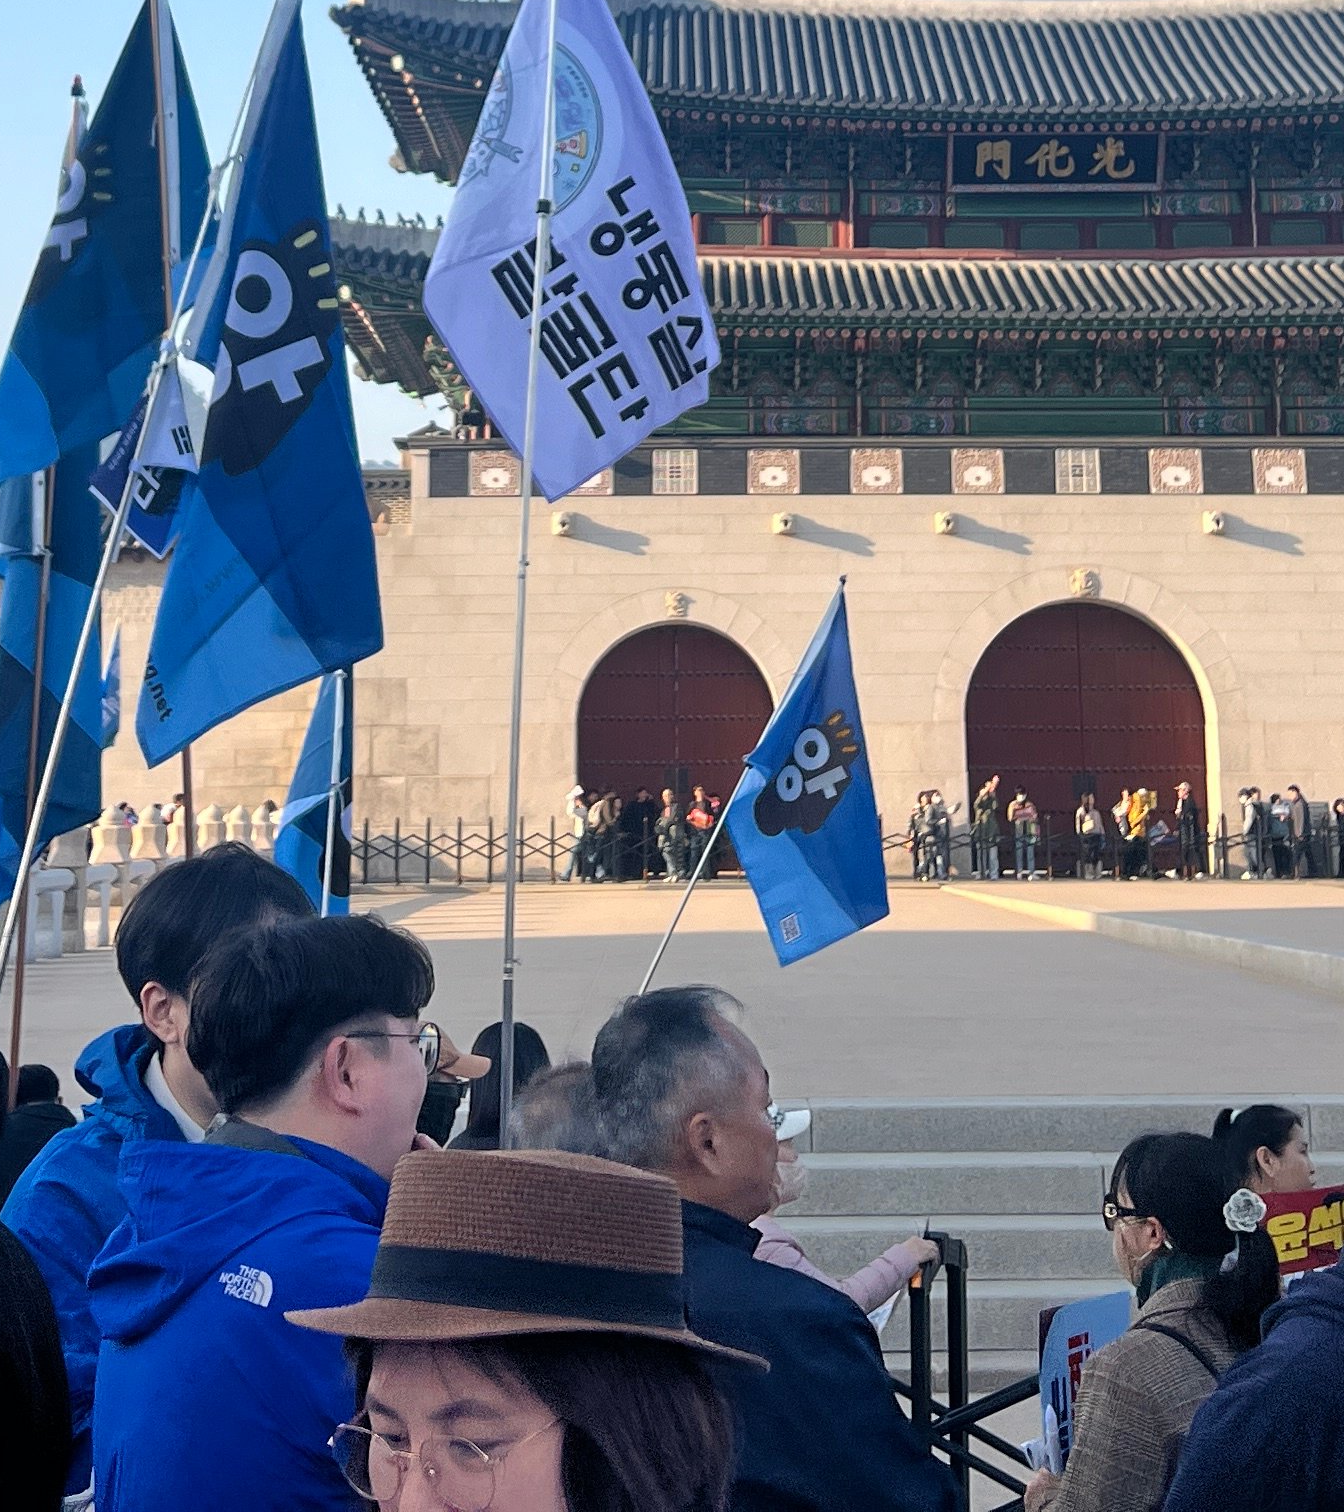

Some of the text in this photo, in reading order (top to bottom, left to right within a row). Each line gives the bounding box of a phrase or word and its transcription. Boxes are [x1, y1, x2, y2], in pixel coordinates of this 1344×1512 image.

[590, 176, 708, 391] 냉동실
[489, 234, 650, 440] 발굴단
[218, 1272, 256, 1291] NORTH
[239, 1264, 261, 1281] THE
[223, 1284, 253, 1301] FACE
